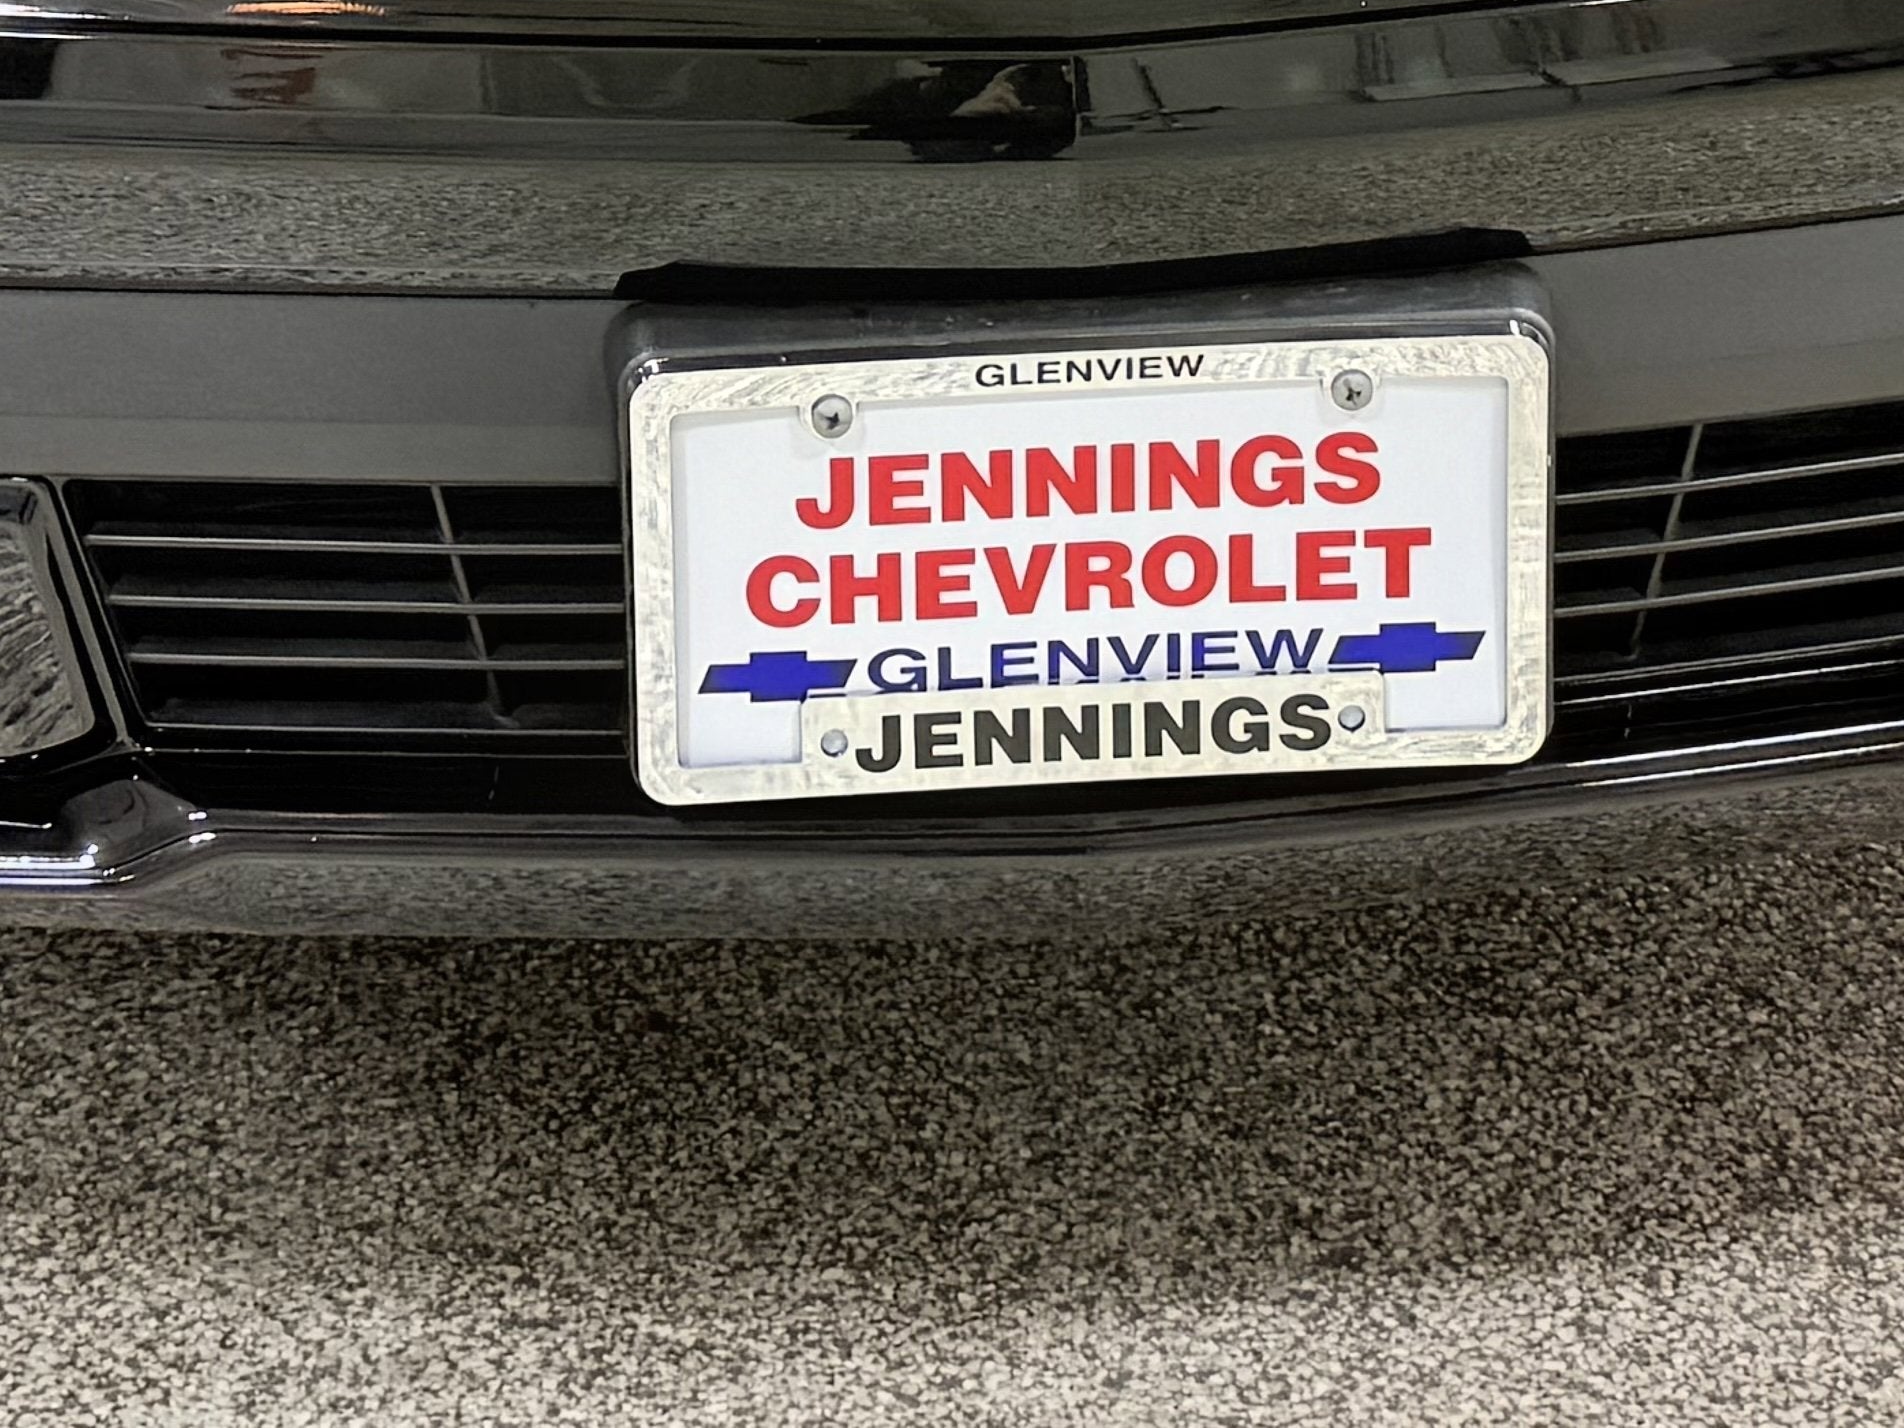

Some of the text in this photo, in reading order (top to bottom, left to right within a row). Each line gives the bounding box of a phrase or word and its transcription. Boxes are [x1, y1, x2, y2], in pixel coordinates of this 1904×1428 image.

[974, 353, 1205, 388] GLENVIEW
[795, 431, 1382, 531] JENNINGS
[745, 527, 1433, 630] CHEVROLET
[866, 627, 1325, 693] GLENVIEW
[854, 692, 1333, 774] JENNINGS
